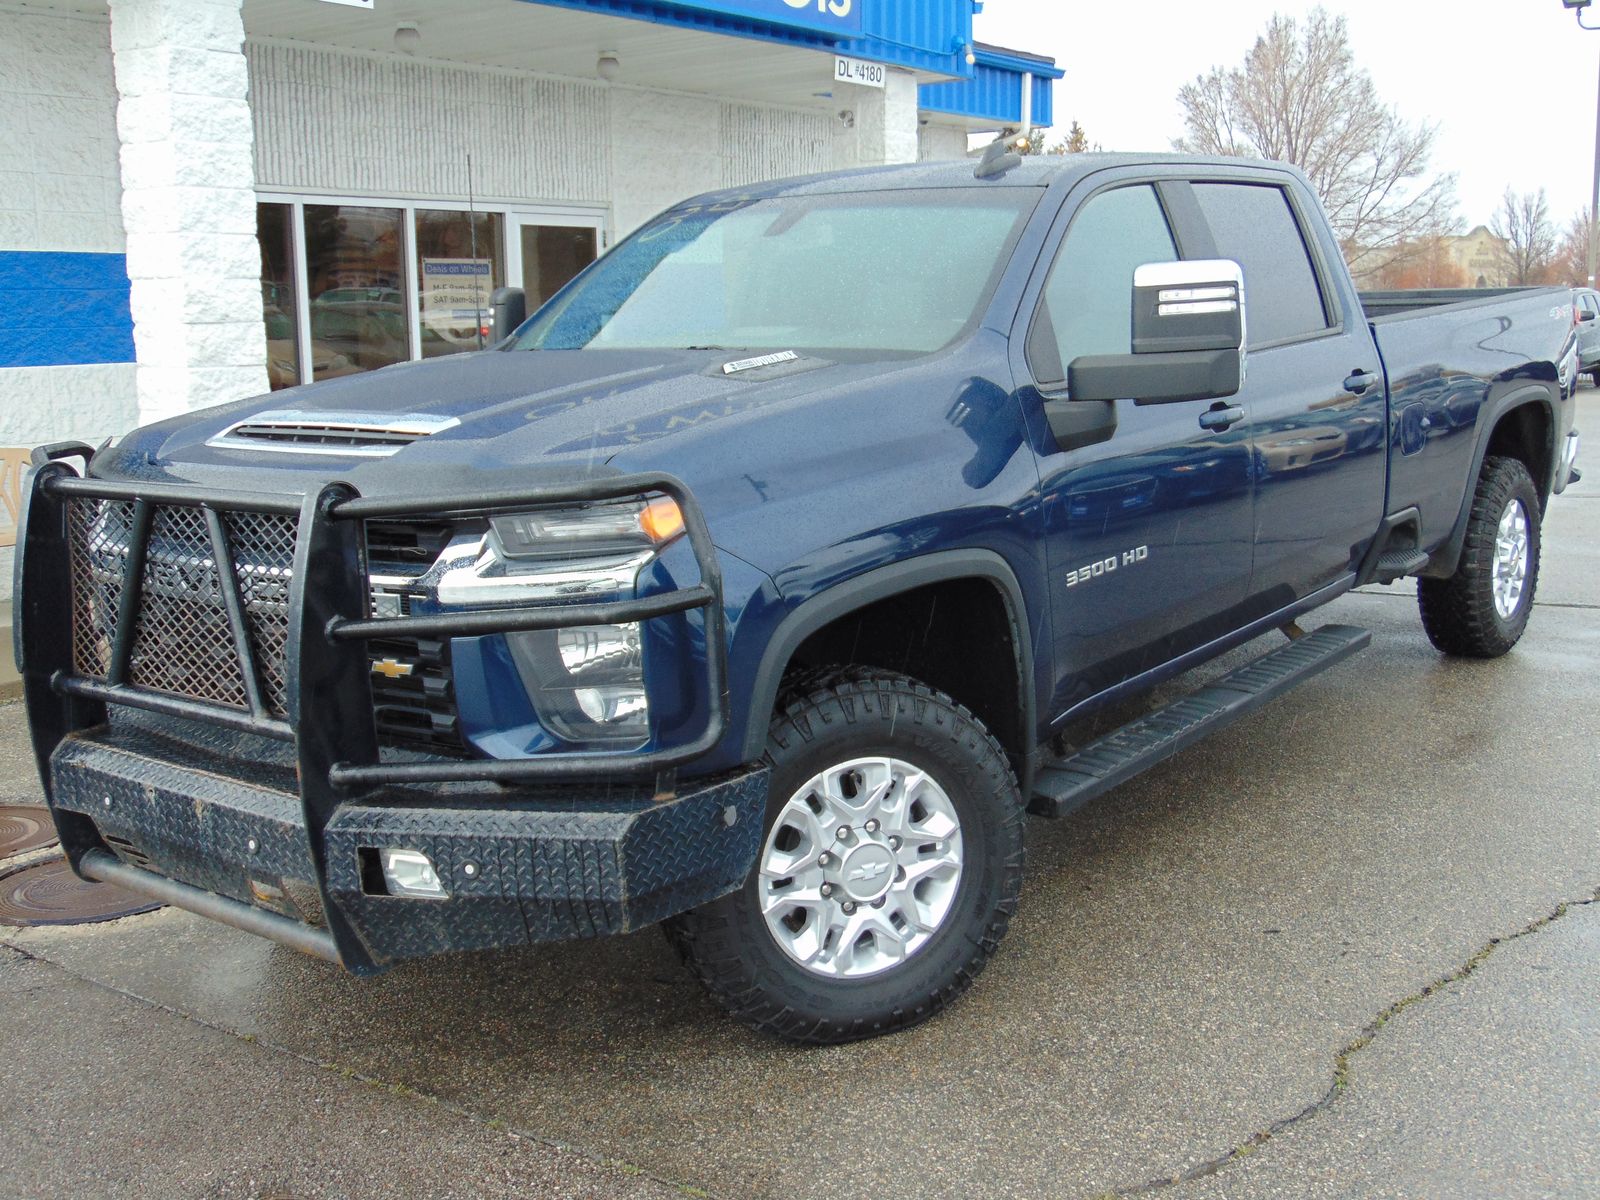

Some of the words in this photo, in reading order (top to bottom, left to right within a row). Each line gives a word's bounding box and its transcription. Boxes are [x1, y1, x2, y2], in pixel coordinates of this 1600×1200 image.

[838, 60, 853, 78] DL
[855, 62, 882, 83] #4180
[449, 265, 460, 273] on
[433, 296, 448, 304] SAT
[1066, 556, 1117, 587] 3500
[1122, 545, 1148, 566] HD
